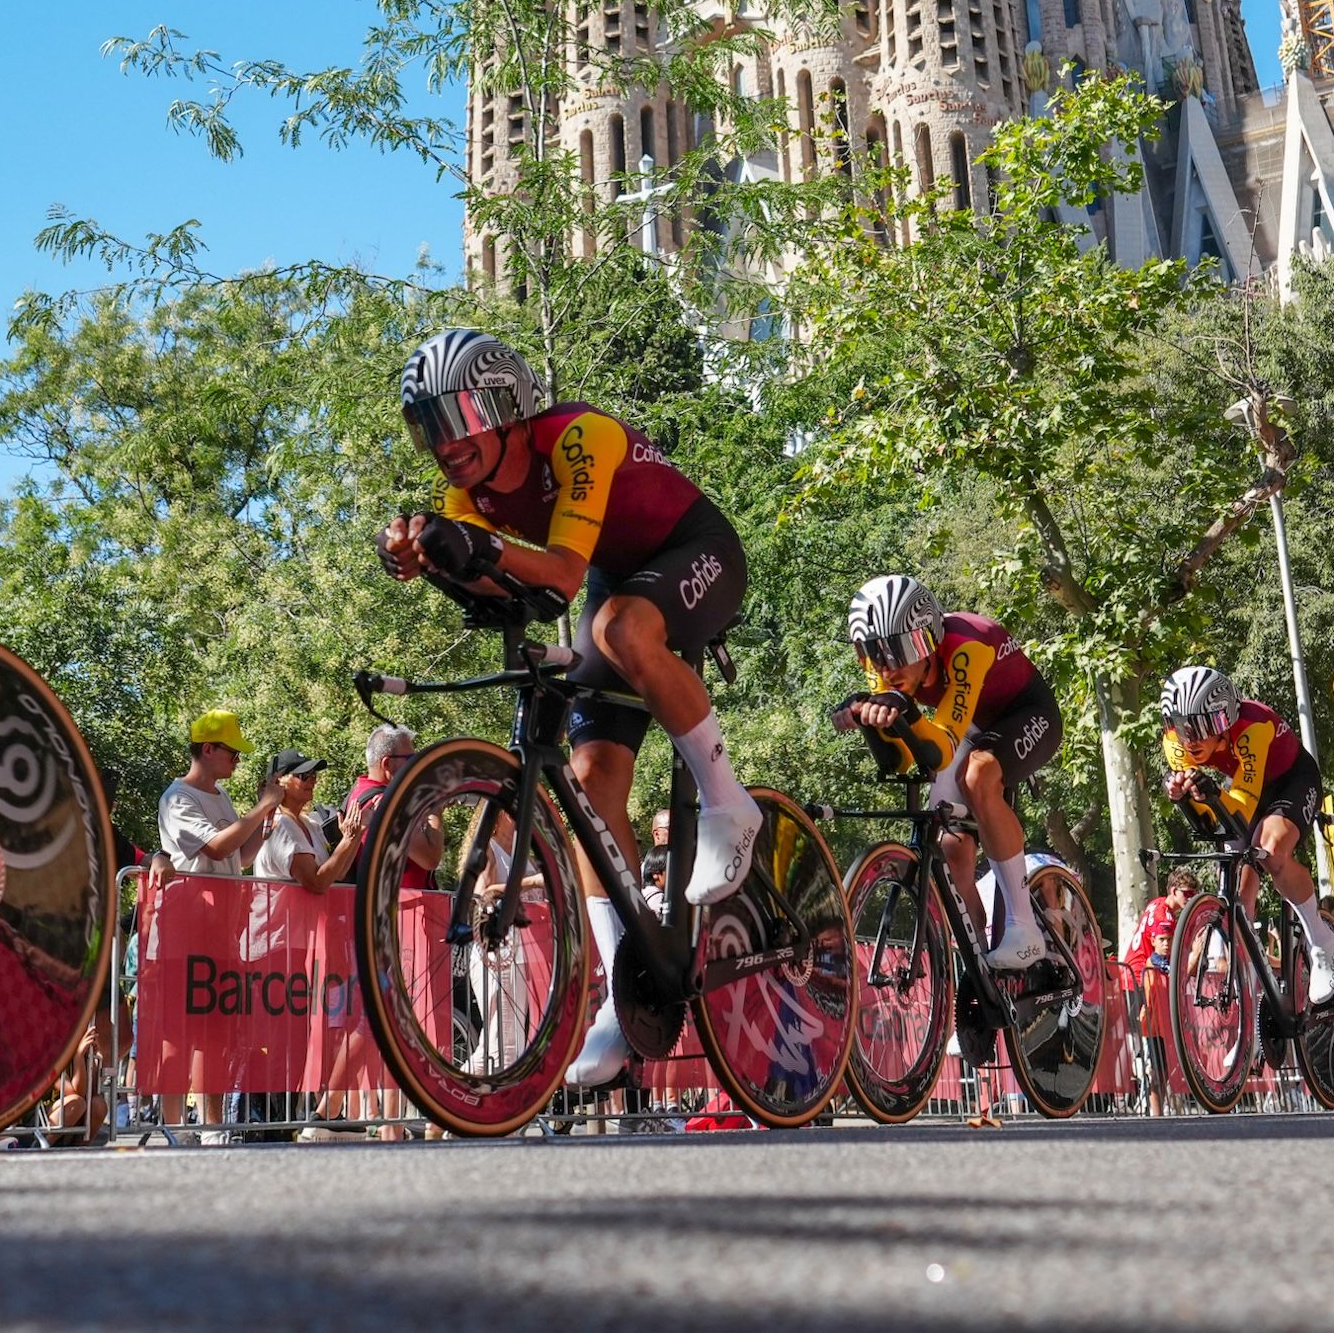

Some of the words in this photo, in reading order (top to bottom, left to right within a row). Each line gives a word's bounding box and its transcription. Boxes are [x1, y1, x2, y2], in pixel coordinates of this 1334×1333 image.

[484, 377, 507, 385] uvex
[562, 425, 595, 502] Cofidis
[679, 554, 723, 610] Cofidis
[951, 651, 971, 723] Cofidis
[1014, 716, 1051, 760] Cofidis
[1236, 735, 1257, 783] Cofidis
[563, 764, 653, 916] LOOK
[724, 827, 755, 882] Cofidis
[736, 954, 763, 969] 796
[776, 947, 794, 959] RS
[1035, 993, 1054, 1004] 796
